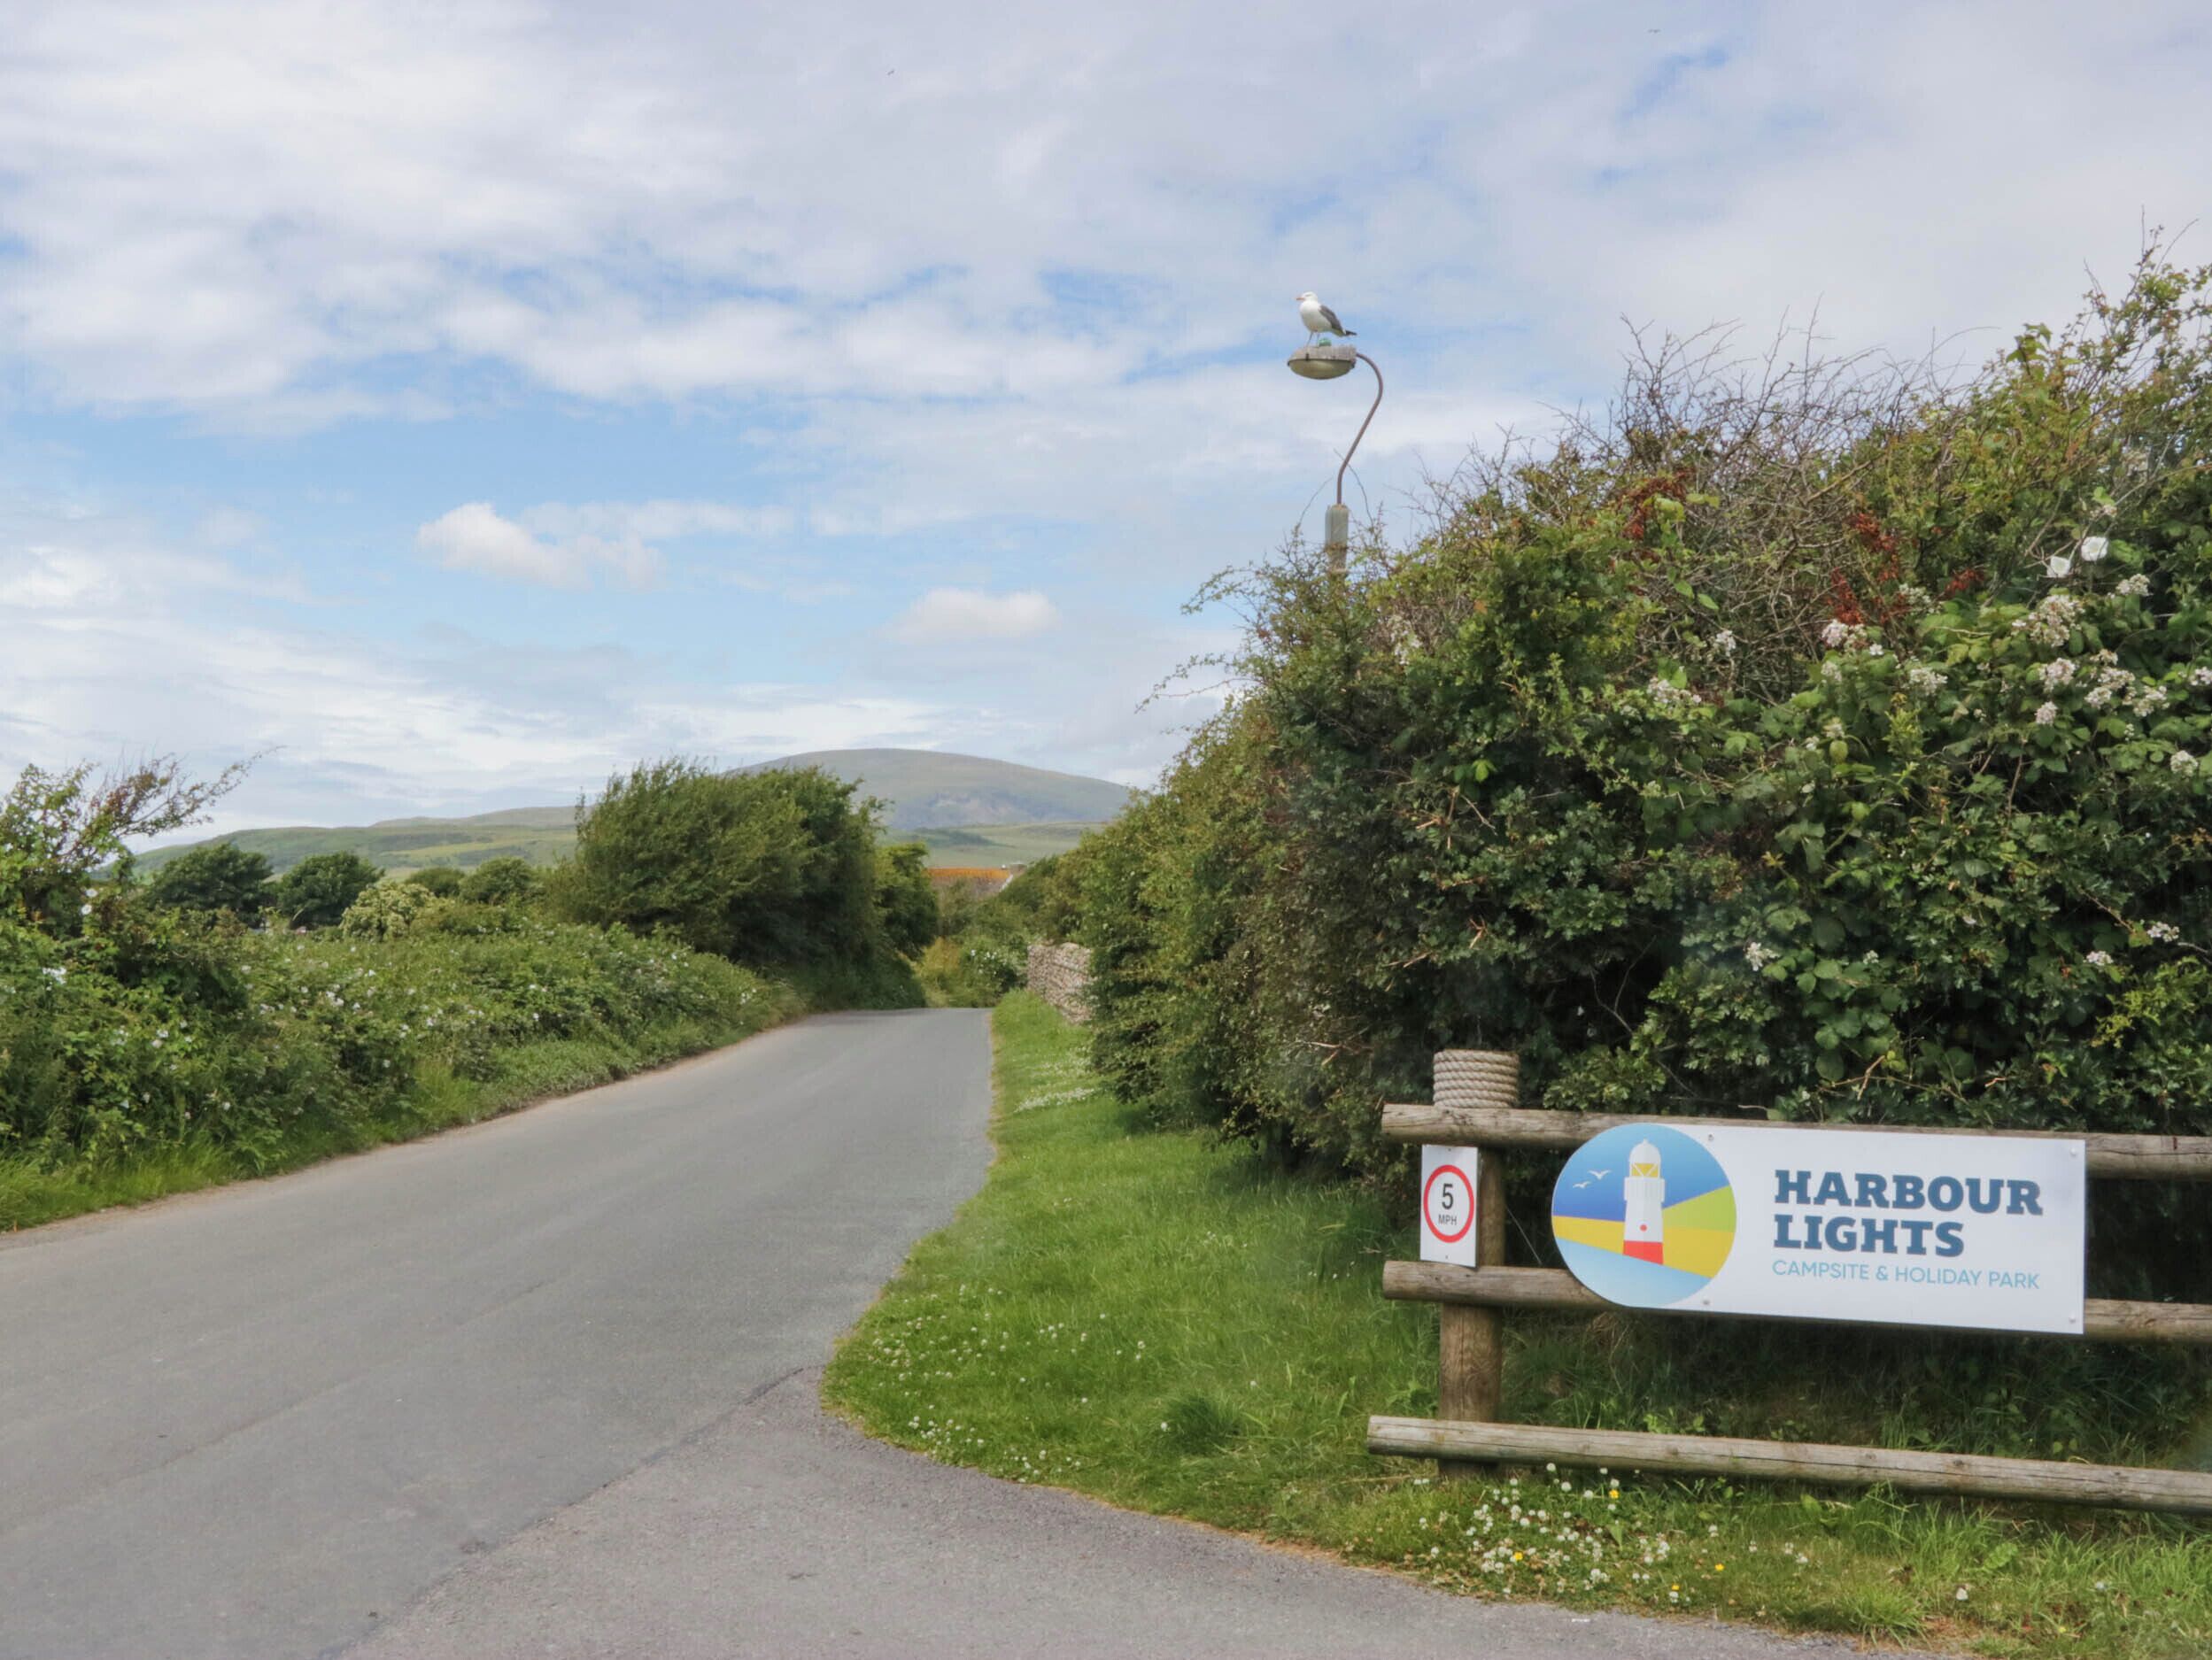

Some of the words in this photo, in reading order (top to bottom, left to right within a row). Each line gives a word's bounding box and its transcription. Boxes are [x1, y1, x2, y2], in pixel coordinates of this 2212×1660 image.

[1442, 1183, 1454, 1209] 5
[1775, 1170, 2044, 1216] HARBOUR
[1438, 1214, 1457, 1225] MPH
[1774, 1214, 1965, 1257] LIGHTS
[1772, 1260, 1869, 1281] CAMPSITE
[1875, 1265, 1889, 1281] &
[1895, 1266, 1983, 1286] HOLIDAY
[1989, 1270, 2040, 1290] PARK
